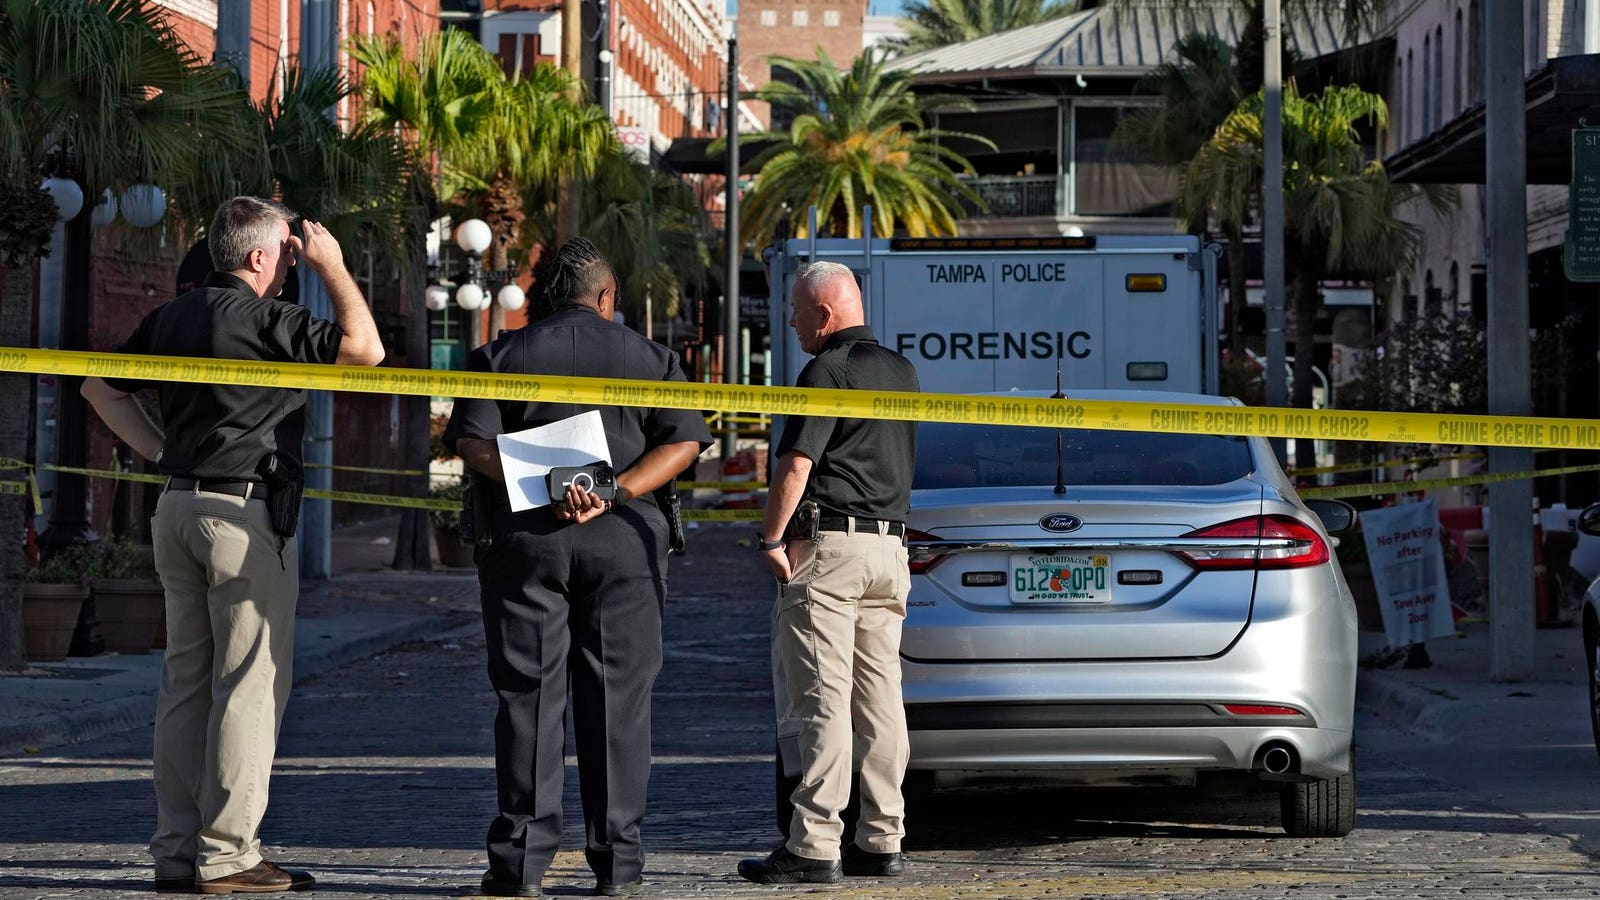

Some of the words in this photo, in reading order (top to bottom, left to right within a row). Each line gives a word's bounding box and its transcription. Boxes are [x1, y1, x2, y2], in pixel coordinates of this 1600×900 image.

[926, 264, 986, 283] TAMPA
[1001, 263, 1066, 282] POLICE
[896, 331, 1092, 361] FORENSIC
[1048, 517, 1074, 528] Ford
[1376, 535, 1393, 548] No
[1394, 526, 1434, 542] Parking
[1395, 545, 1424, 559] after
[1015, 567, 1049, 591] 612
